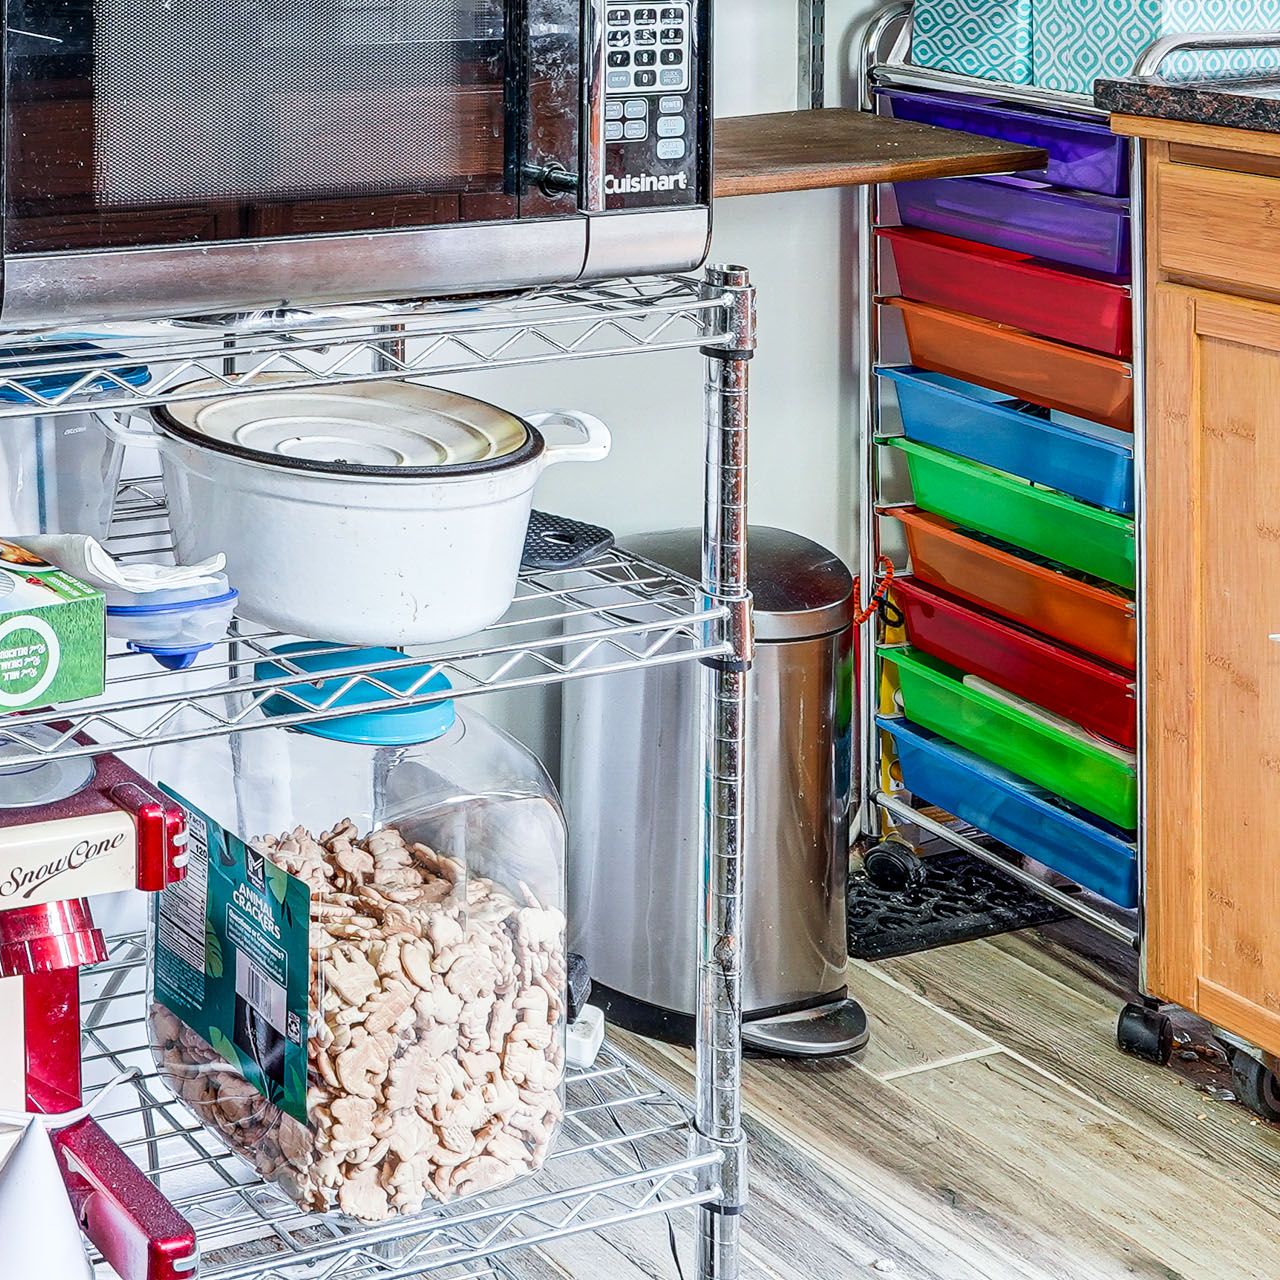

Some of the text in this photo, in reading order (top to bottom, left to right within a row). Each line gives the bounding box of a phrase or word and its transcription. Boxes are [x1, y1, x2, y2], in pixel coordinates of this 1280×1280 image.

[642, 9, 675, 19] 2 3
[669, 31, 675, 39] 6
[616, 52, 674, 64] 7 8 9
[642, 73, 648, 83] 0
[605, 171, 687, 195] Cuisinart
[196, 844, 207, 859] 120
[239, 882, 276, 923] ANIMAL
[232, 890, 281, 940] CRACKERS
